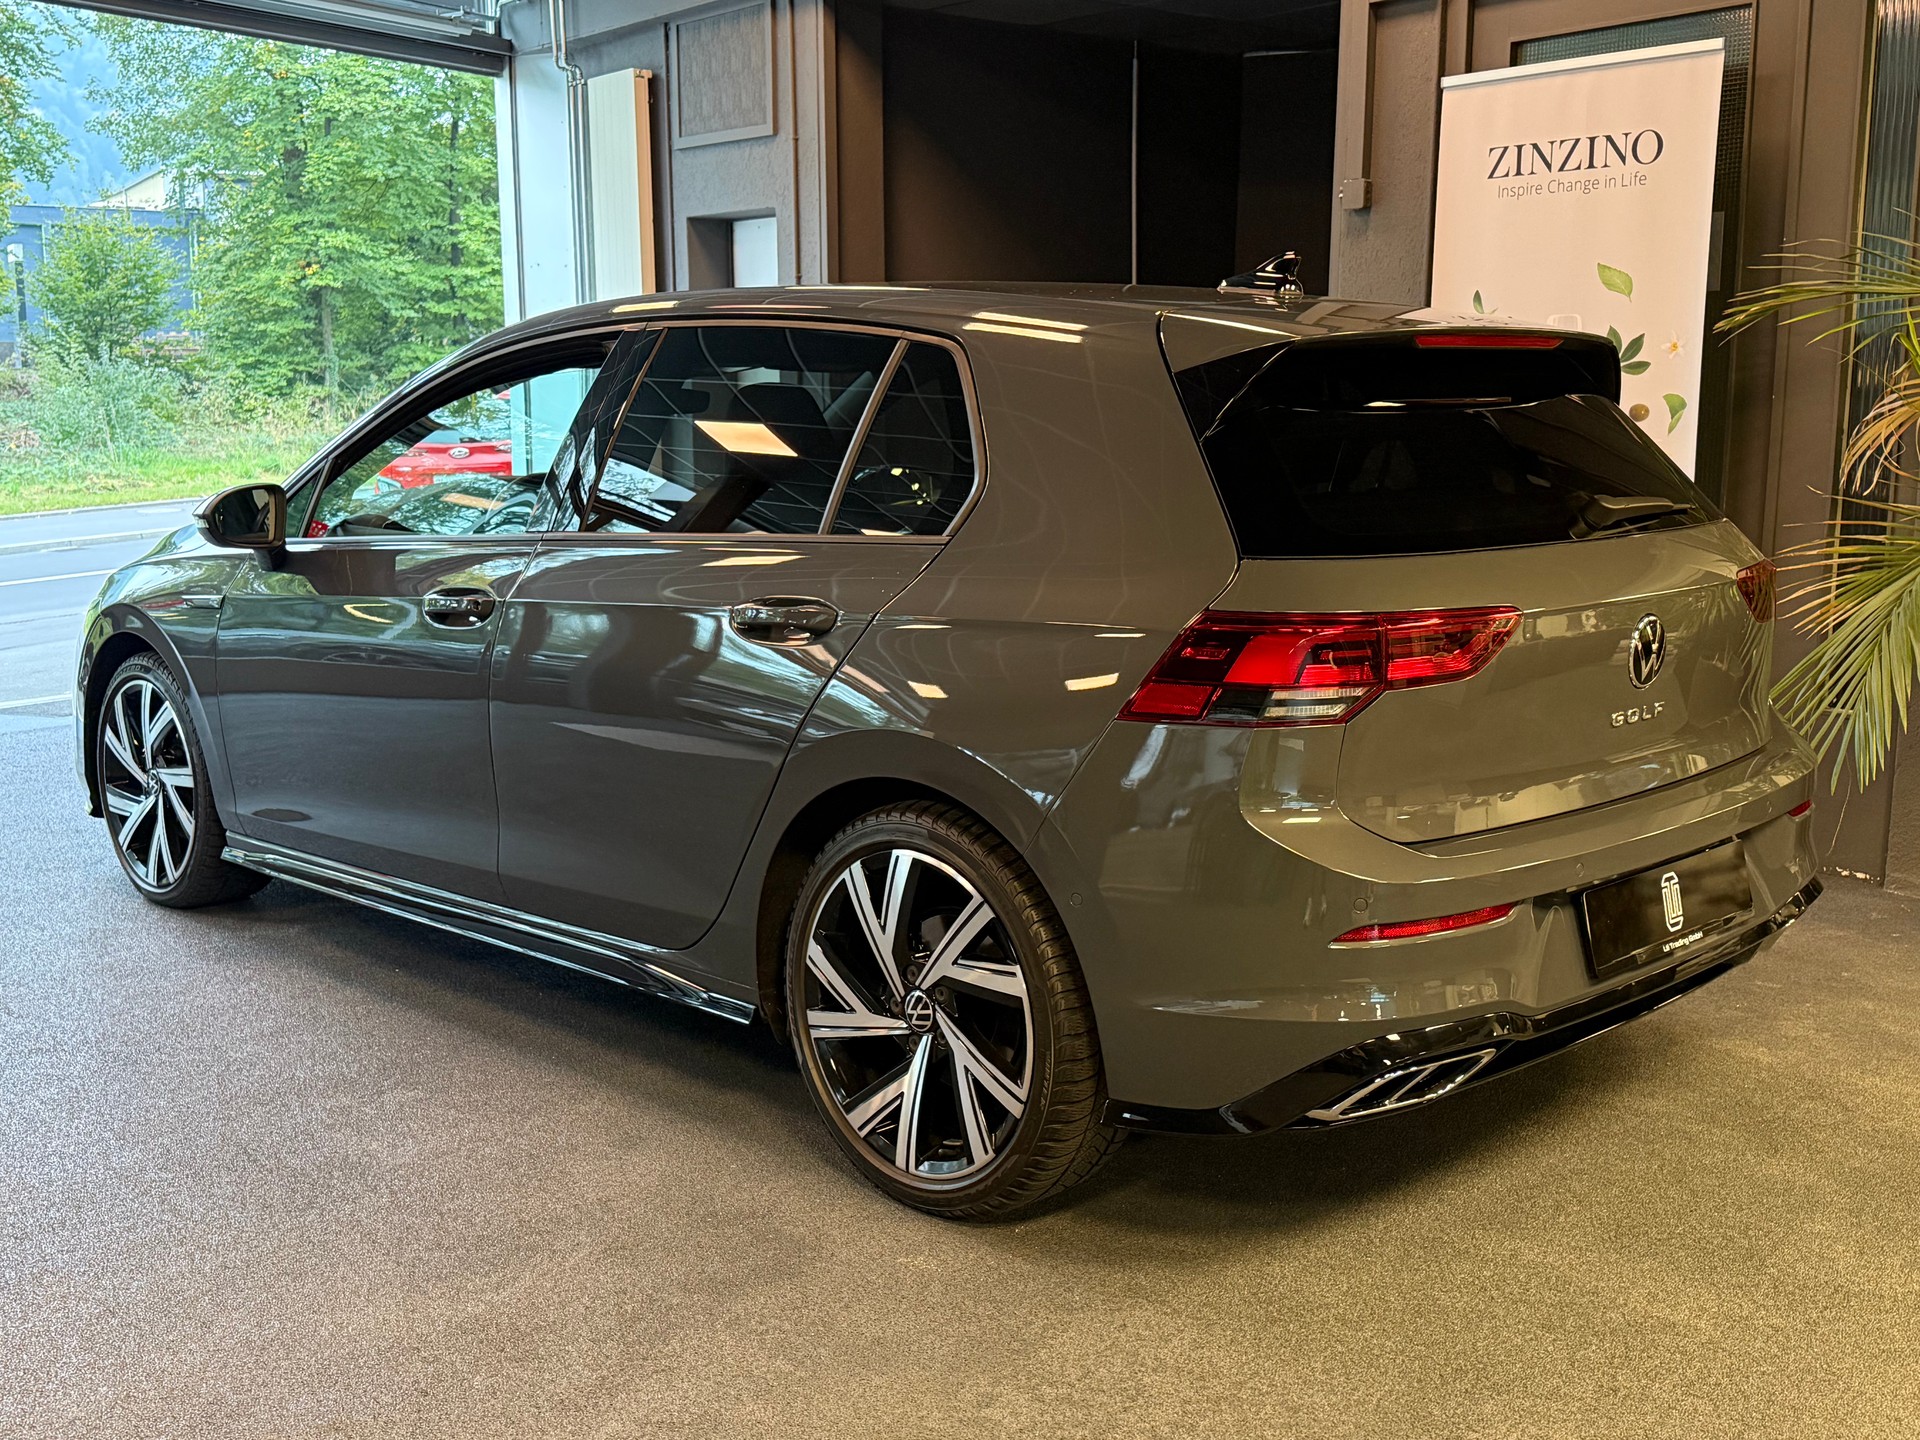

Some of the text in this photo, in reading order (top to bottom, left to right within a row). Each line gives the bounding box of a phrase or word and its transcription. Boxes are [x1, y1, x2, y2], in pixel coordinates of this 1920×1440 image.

[1487, 129, 1664, 179] ZINZINO
[1497, 171, 1647, 200] Inspire Change in Life
[1611, 701, 1665, 727] GOLF
